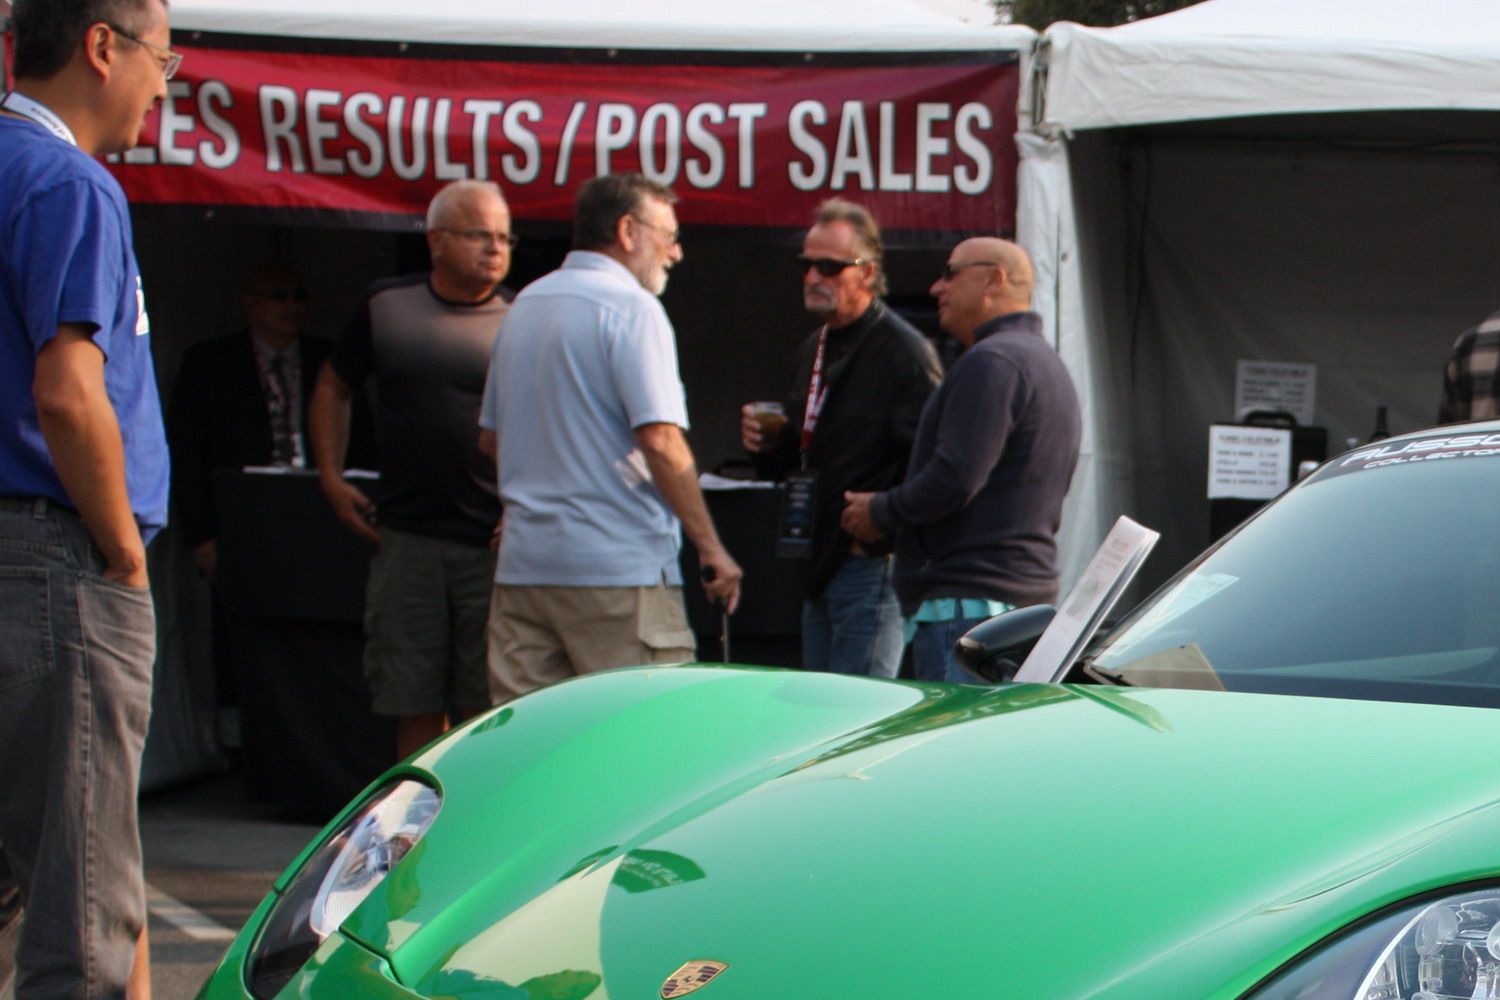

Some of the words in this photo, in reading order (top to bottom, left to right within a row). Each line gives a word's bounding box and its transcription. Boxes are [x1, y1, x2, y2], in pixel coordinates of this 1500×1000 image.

[258, 84, 543, 185] RESULTS
[595, 102, 767, 189] POST
[787, 100, 993, 195] SALES
